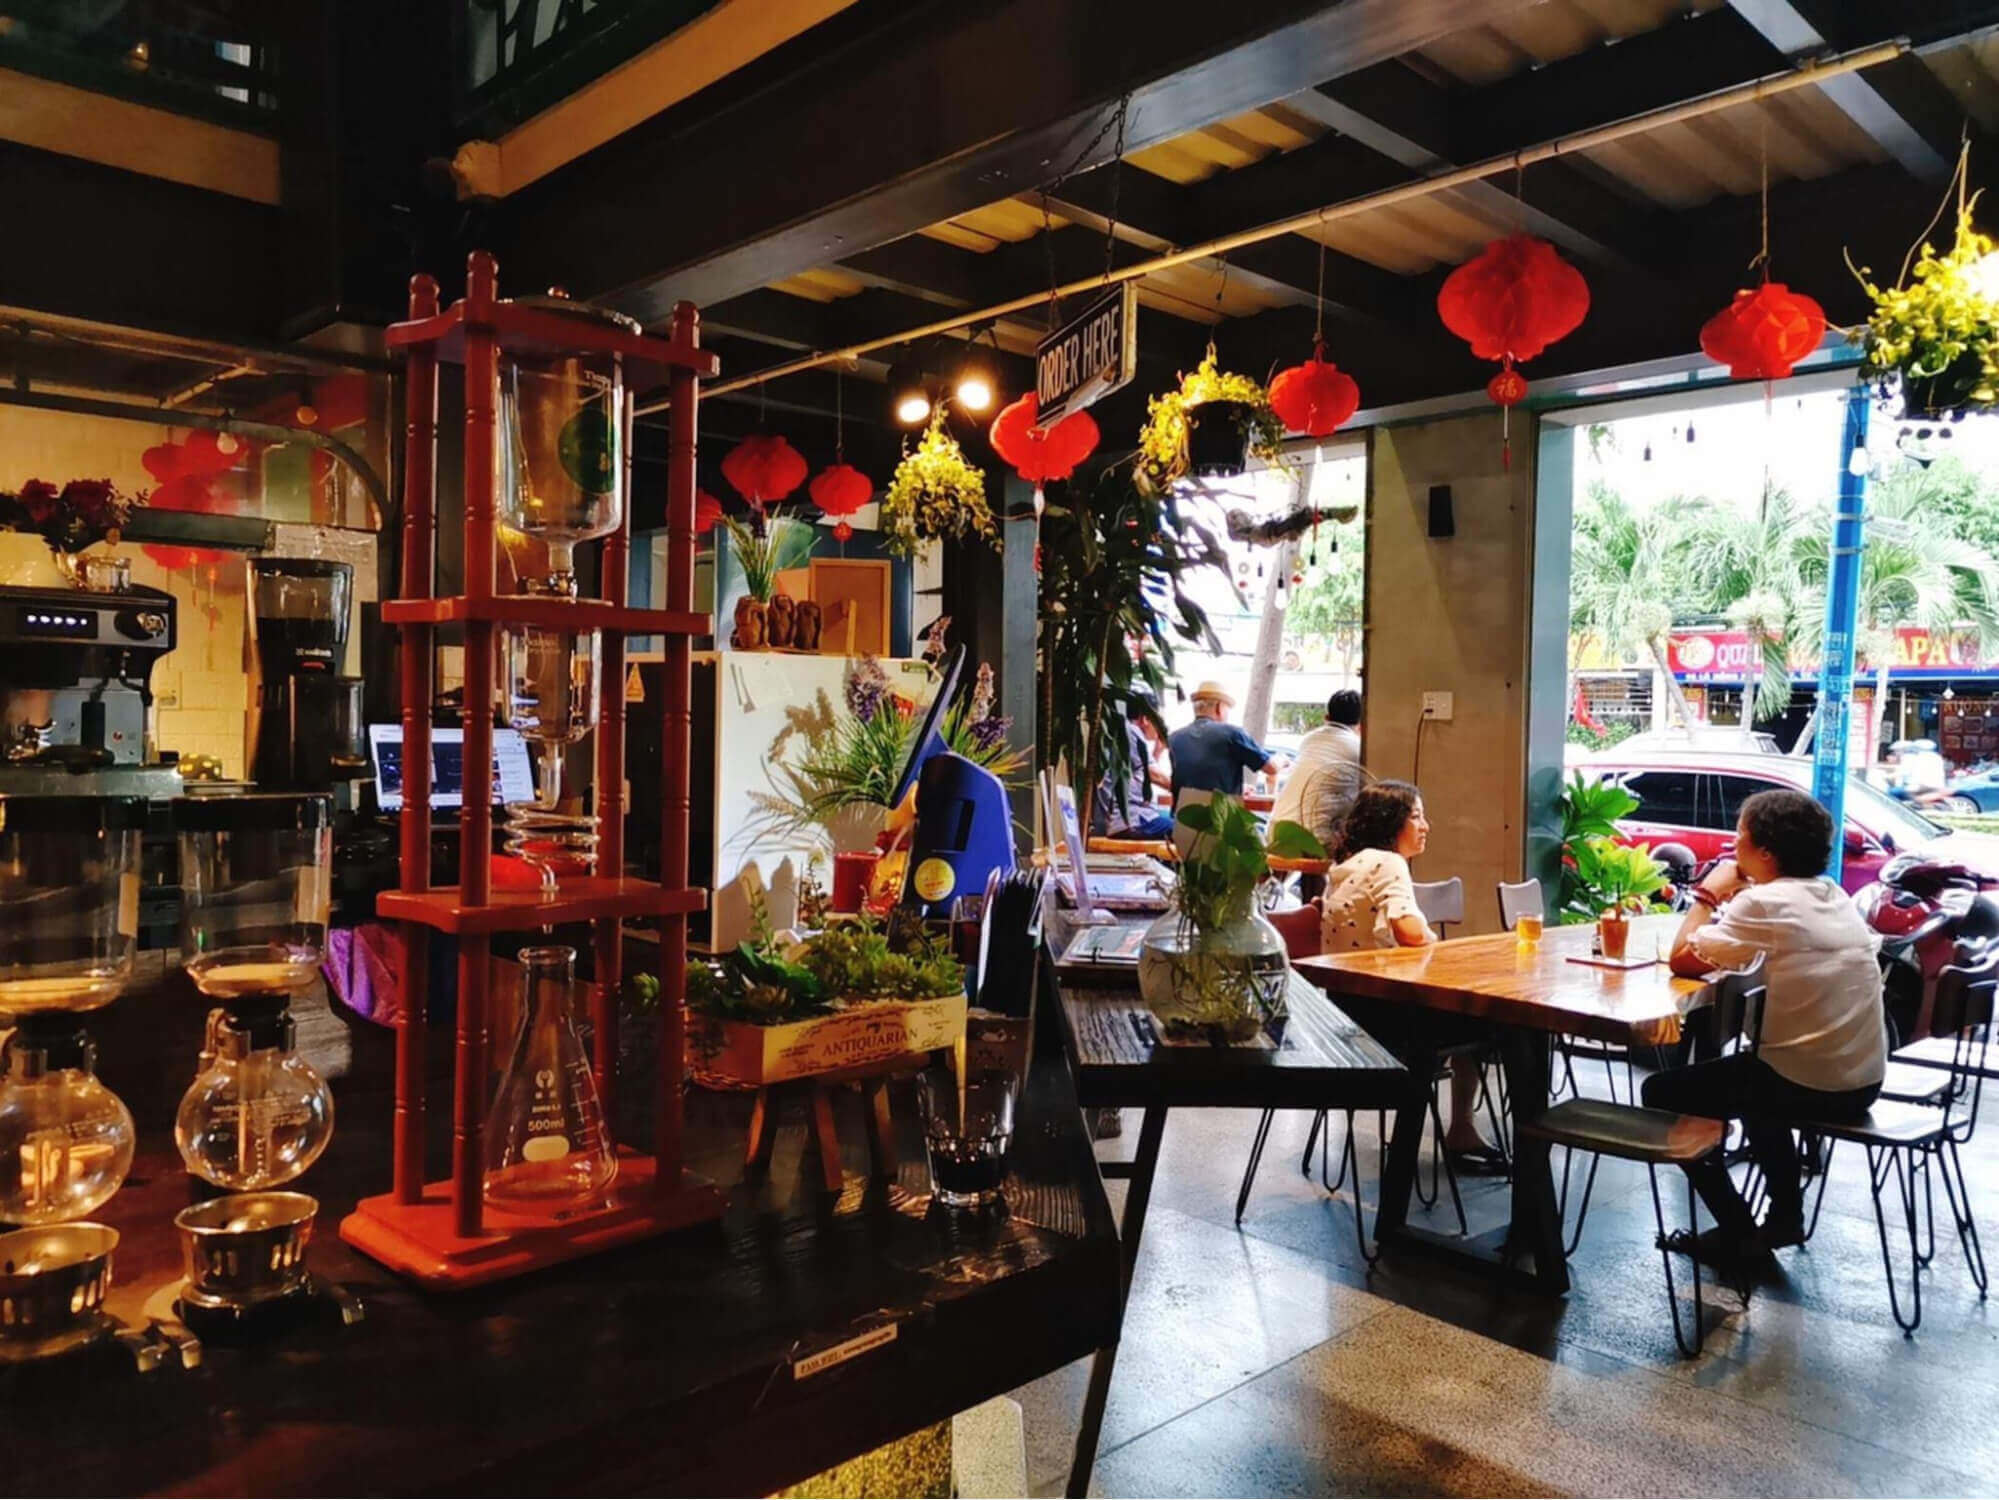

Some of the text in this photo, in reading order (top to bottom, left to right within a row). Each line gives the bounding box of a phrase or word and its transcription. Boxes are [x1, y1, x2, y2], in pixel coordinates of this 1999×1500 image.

[1038, 304, 1120, 407] ORDER HERE
[822, 1027, 918, 1057] ANTIQUARIAN
[528, 1117, 565, 1132] 500ml
